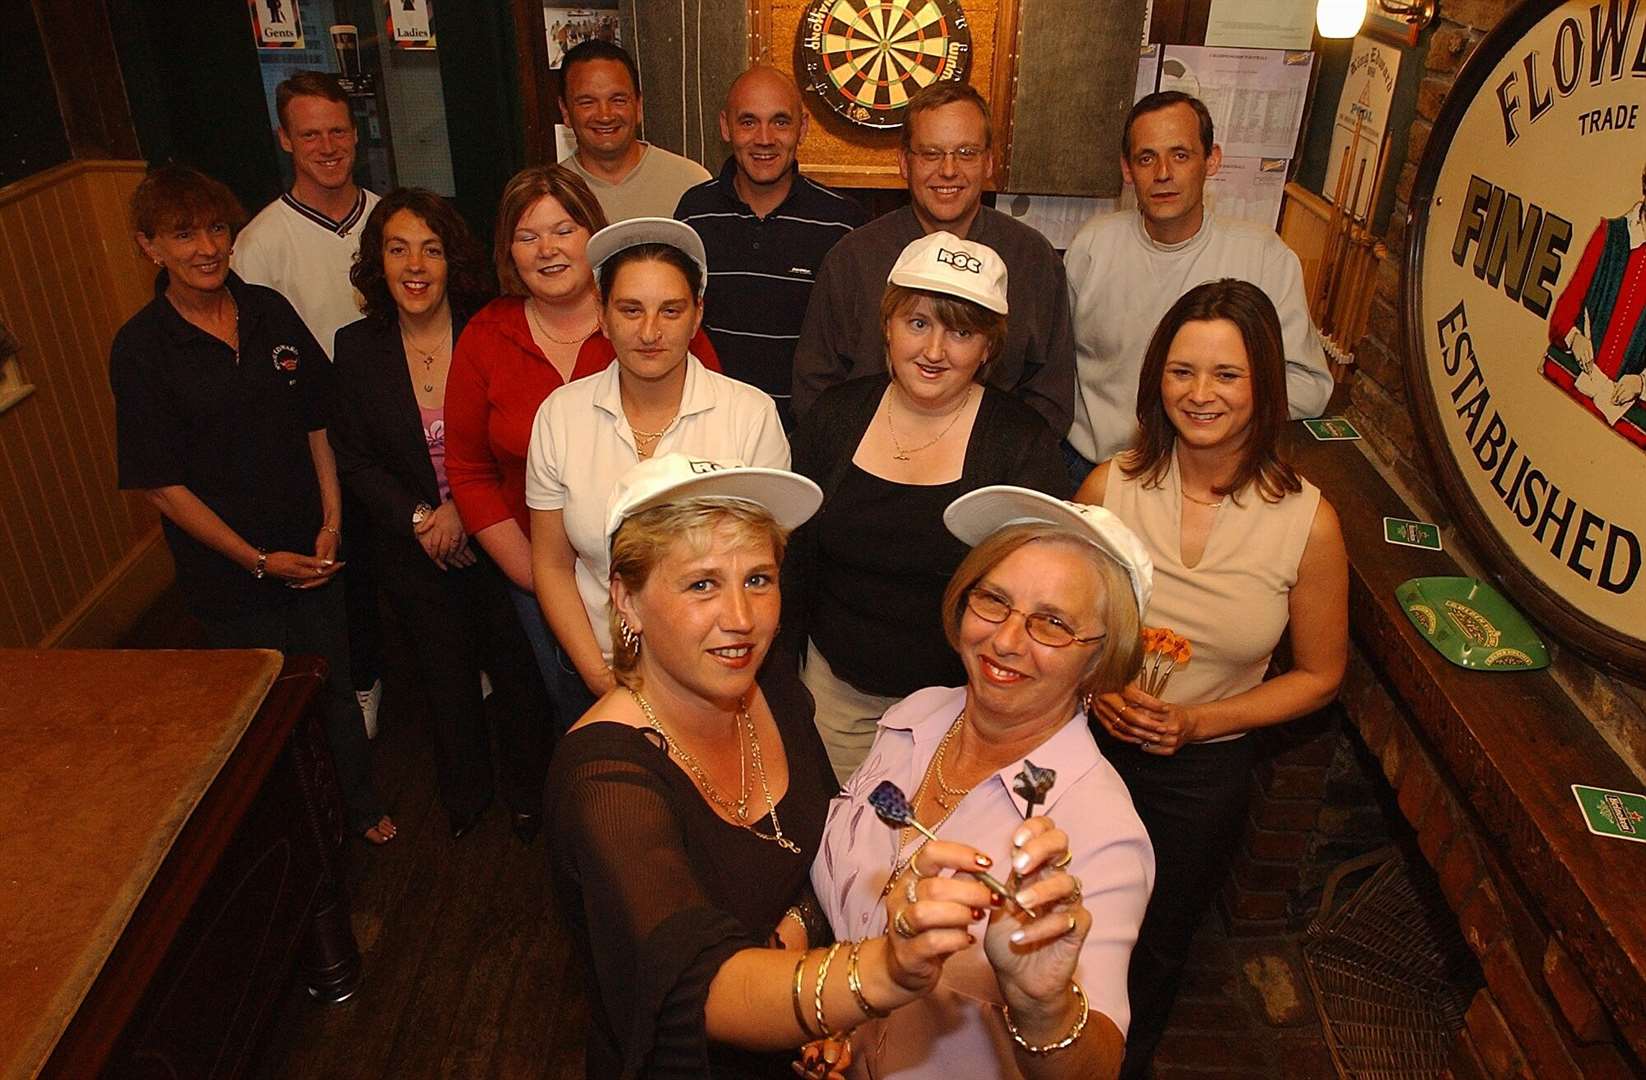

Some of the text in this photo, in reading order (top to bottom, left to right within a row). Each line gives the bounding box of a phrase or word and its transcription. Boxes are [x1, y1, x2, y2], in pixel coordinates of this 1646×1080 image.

[264, 28, 294, 38] Gents
[397, 28, 428, 38] Ladies
[812, 0, 836, 50] IAMOND
[1578, 104, 1639, 137] TRADE
[937, 247, 982, 274] ROC
[1451, 173, 1573, 320] FINE
[1437, 299, 1642, 595] ESTABLISHED
